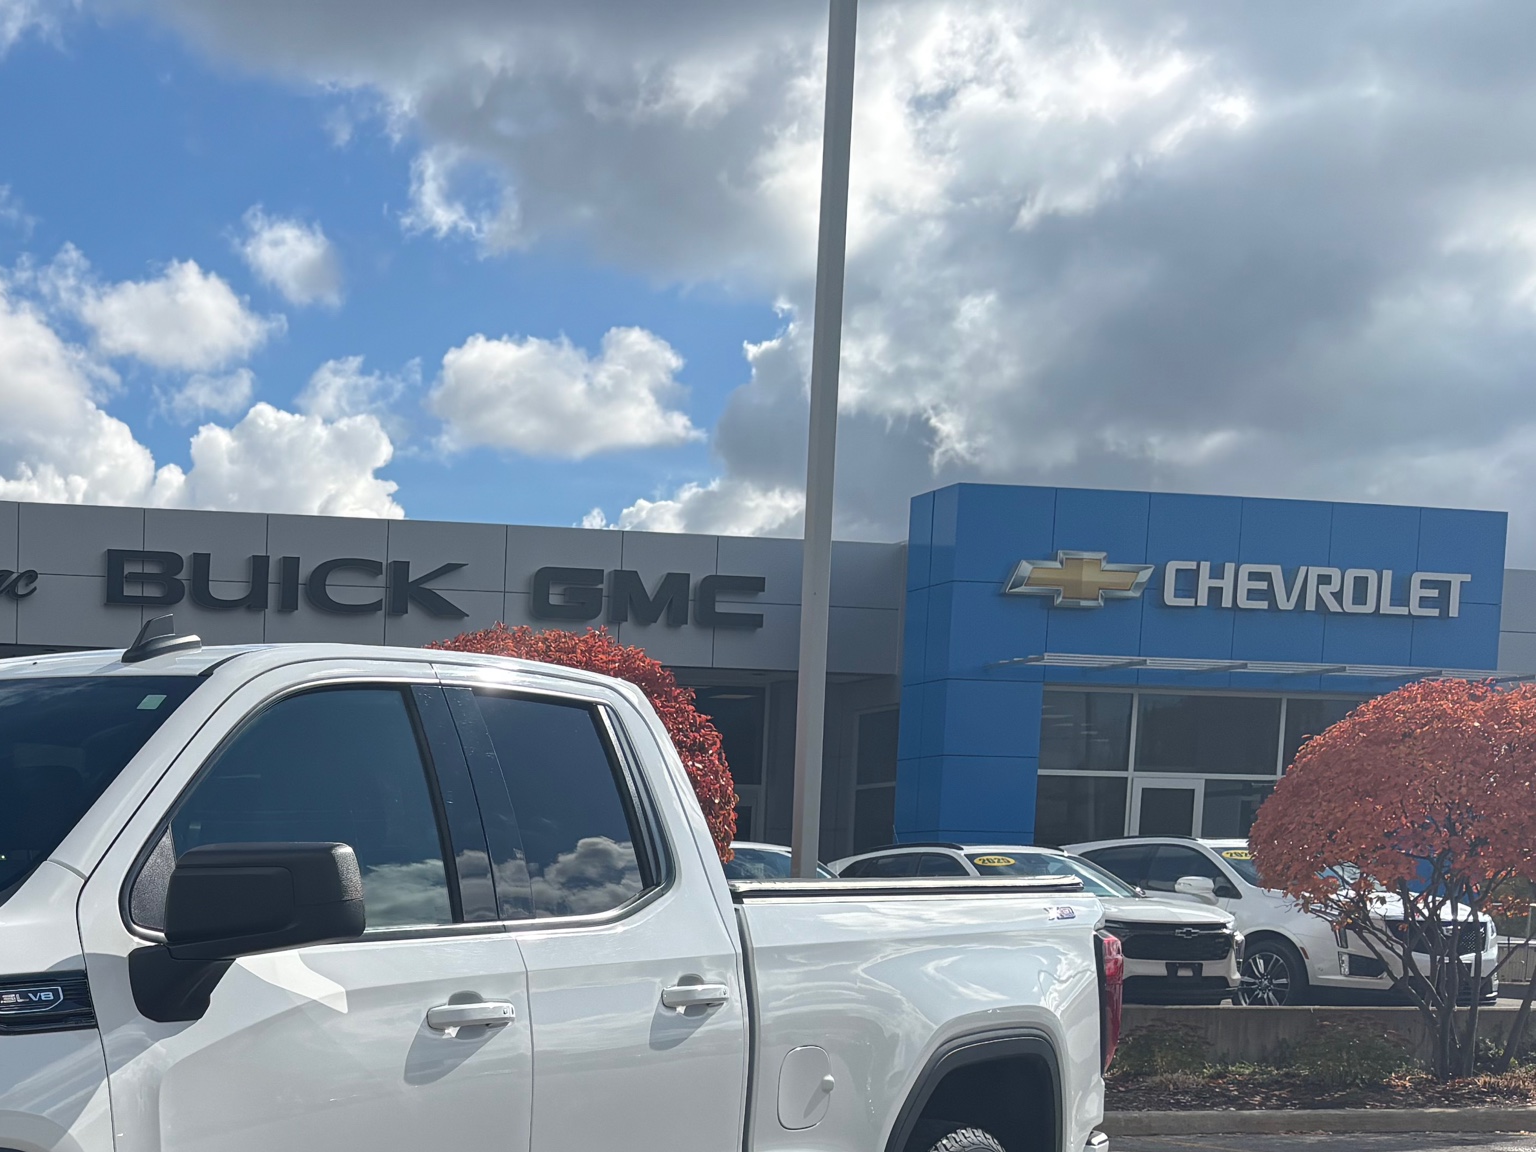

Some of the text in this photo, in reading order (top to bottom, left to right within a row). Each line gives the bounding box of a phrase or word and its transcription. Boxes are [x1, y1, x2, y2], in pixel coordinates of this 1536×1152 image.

[105, 549, 470, 617] BUICK
[531, 567, 766, 627] GMC
[1164, 561, 1472, 618] CHEVROLET
[28, 991, 54, 1001] V8
